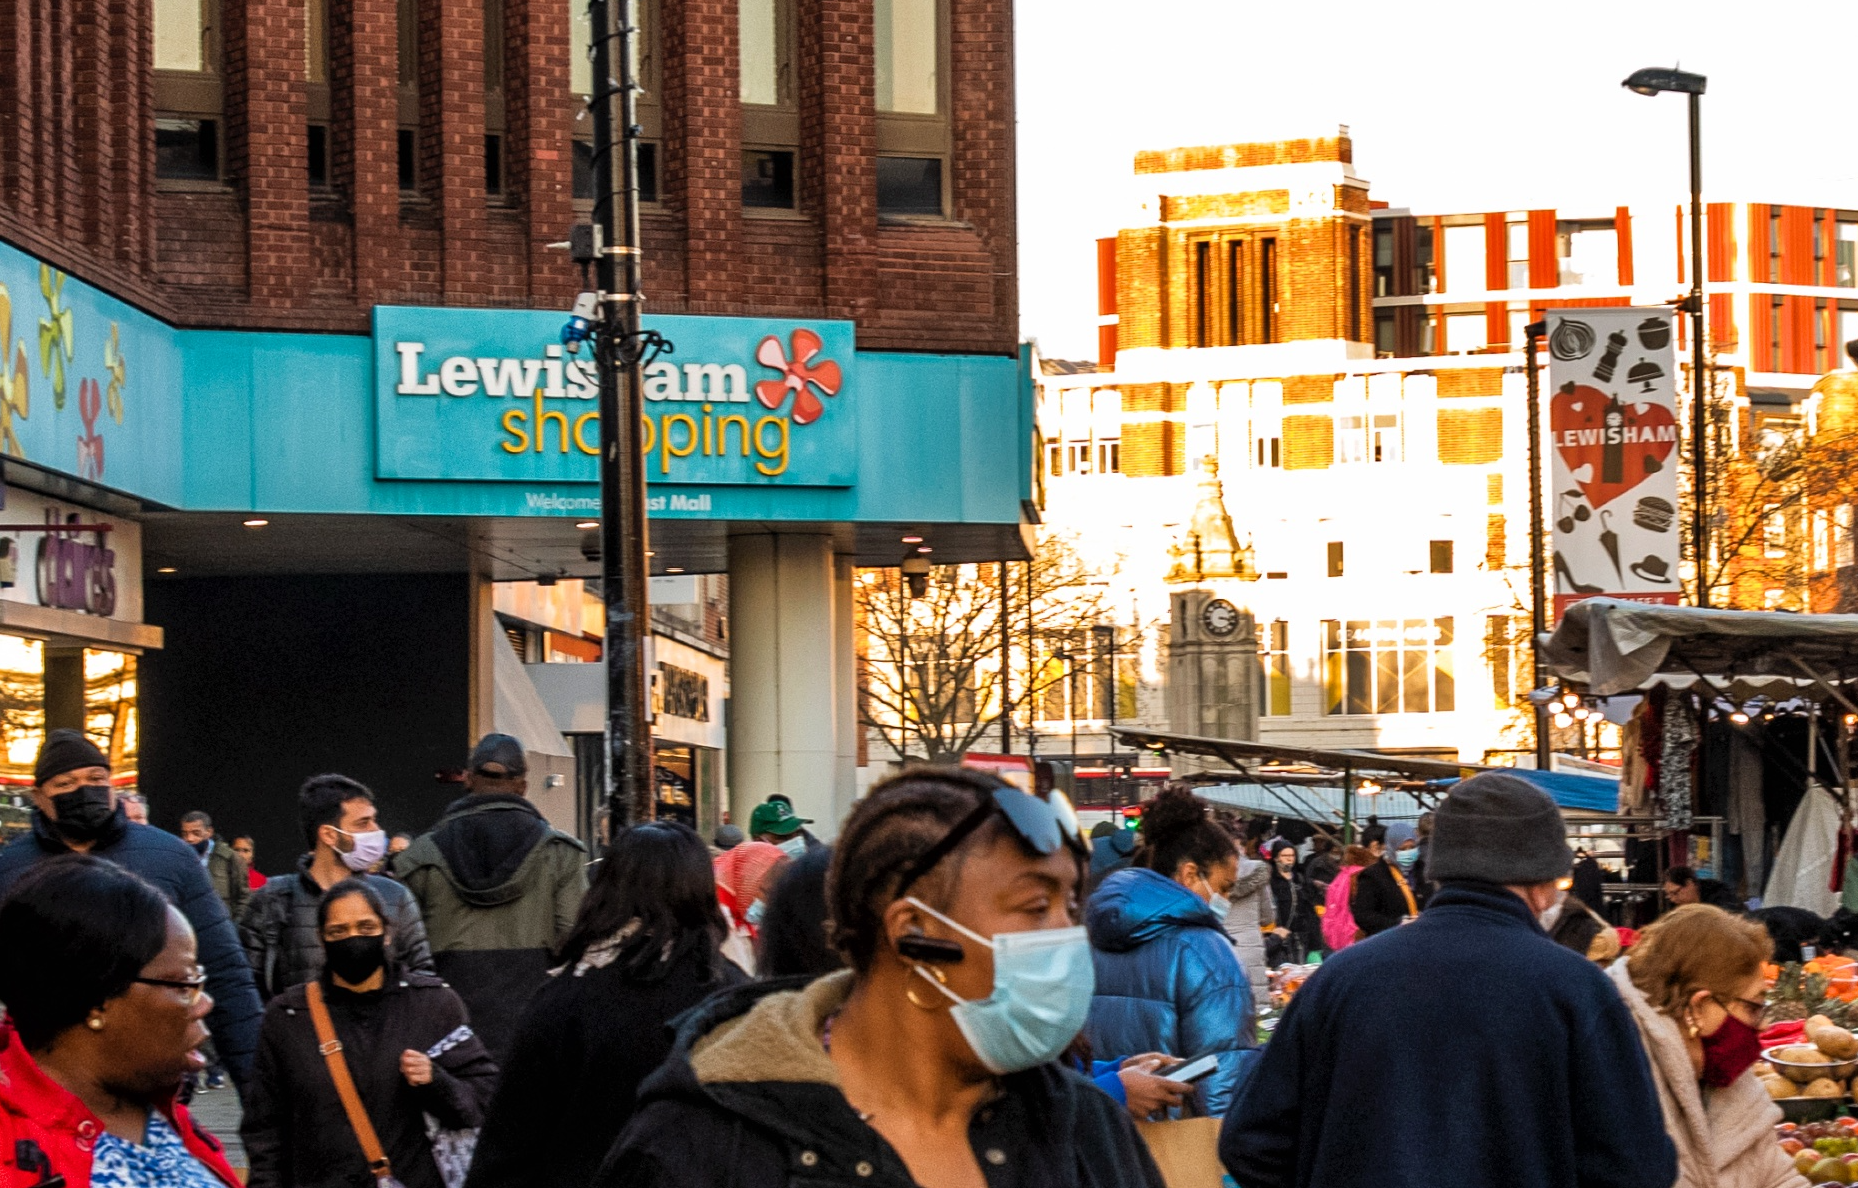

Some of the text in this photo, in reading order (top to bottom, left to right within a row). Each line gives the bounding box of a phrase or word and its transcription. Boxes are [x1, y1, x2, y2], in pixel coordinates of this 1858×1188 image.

[396, 341, 750, 402] Lewisam
[1551, 424, 1677, 448] LEWISHAM
[525, 492, 602, 511] Welcome
[670, 494, 712, 512] Mall
